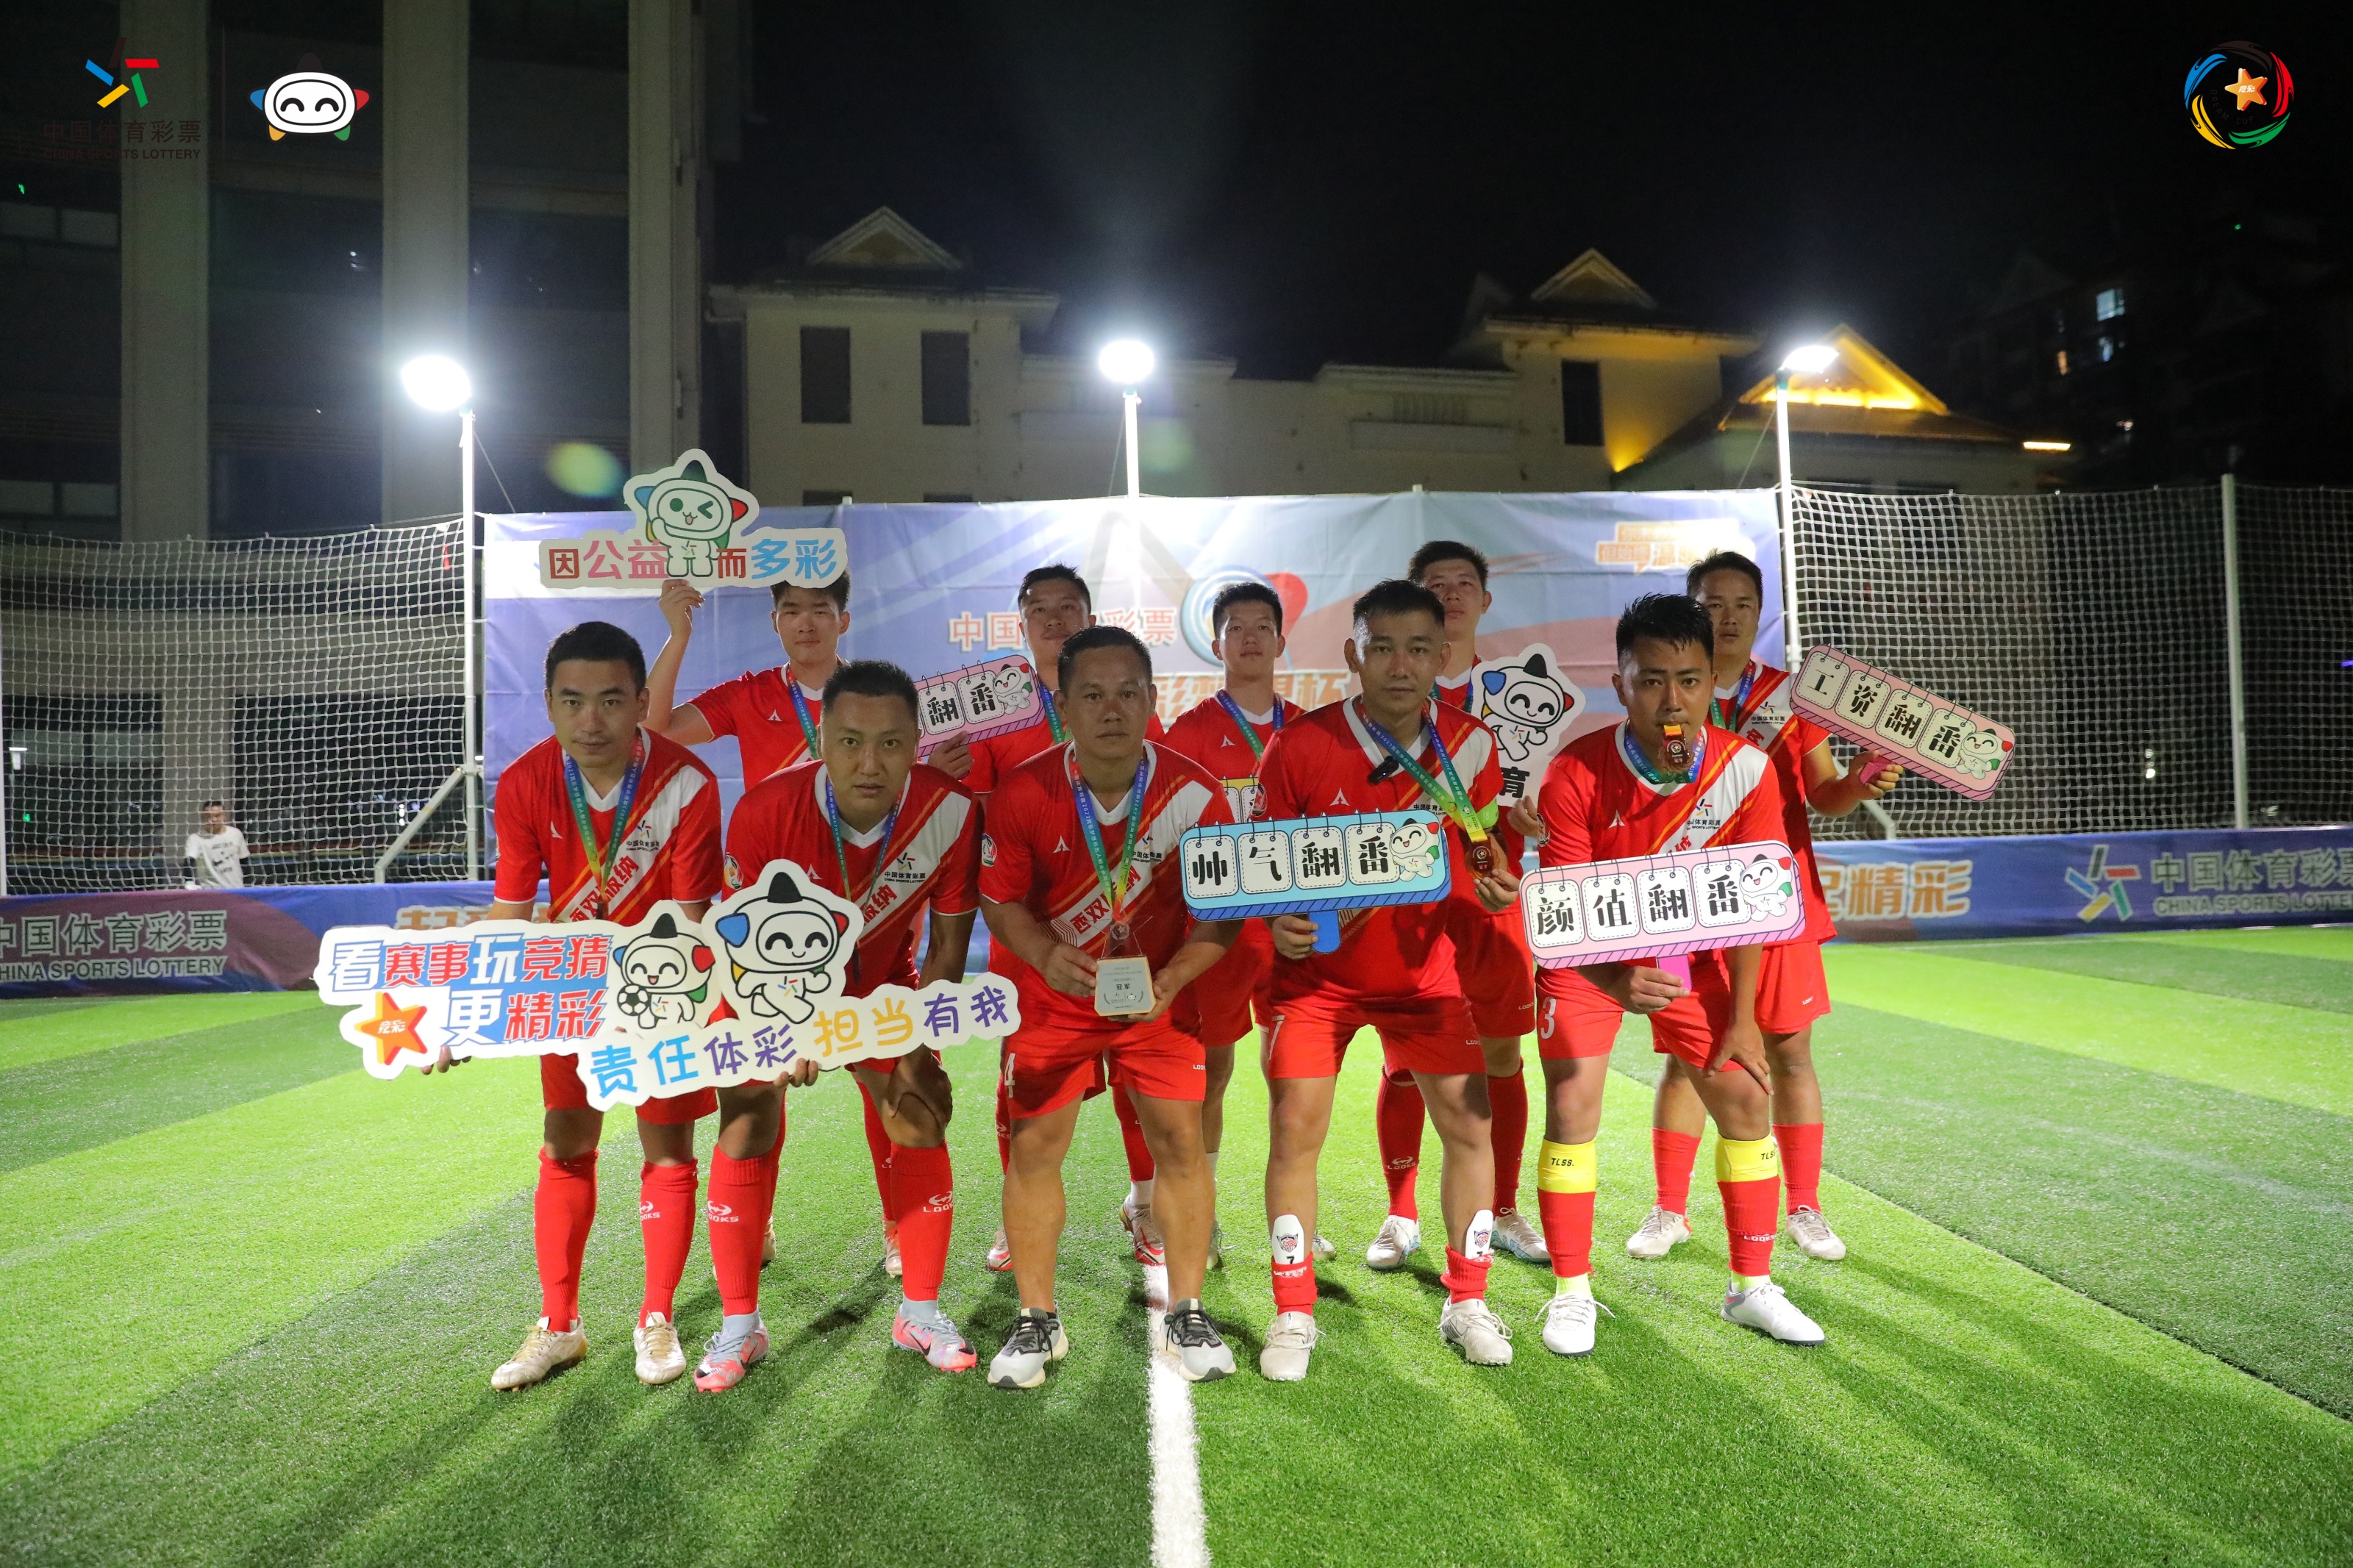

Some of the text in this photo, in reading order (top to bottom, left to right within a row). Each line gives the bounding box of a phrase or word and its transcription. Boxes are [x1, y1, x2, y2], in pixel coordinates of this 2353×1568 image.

[926, 682, 996, 726] 翻番
[1807, 670, 1962, 759] 工资翻番
[1192, 835, 1390, 886] 帅气翻番
[1537, 874, 1740, 935] 颜值翻番
[2156, 892, 2353, 916] CHINA SPORTS LOTTE
[50, 959, 129, 979] SPORTS
[135, 957, 224, 976] LOTTERY
[332, 934, 611, 992] 看赛事玩竞猜
[377, 1020, 406, 1034] 竞彩
[443, 989, 608, 1045] 更精彩
